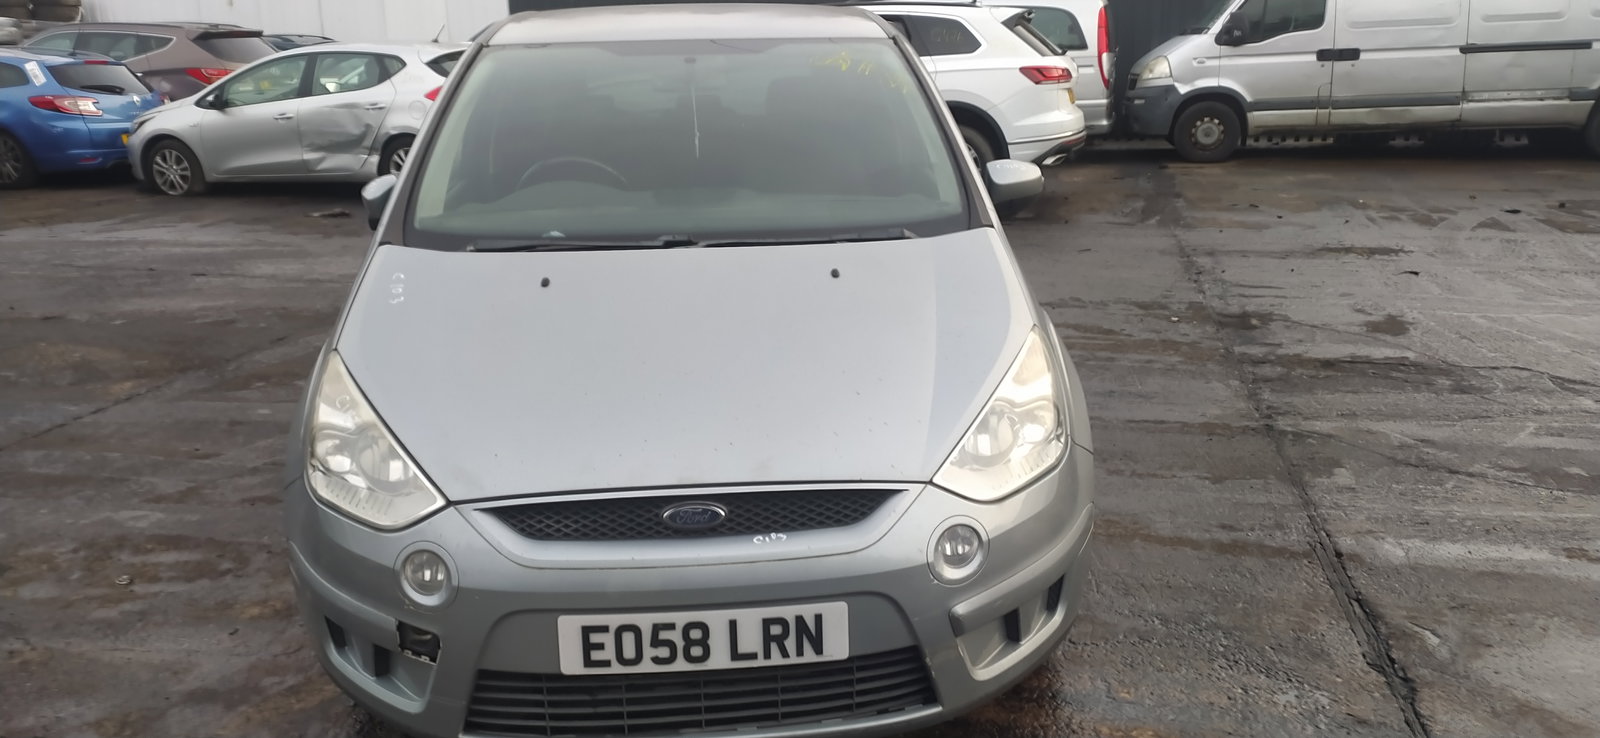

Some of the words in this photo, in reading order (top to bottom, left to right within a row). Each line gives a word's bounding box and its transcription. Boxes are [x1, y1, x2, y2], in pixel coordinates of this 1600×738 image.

[676, 508, 712, 525] Ford
[581, 622, 710, 668] EO58
[728, 613, 824, 662] LRN
